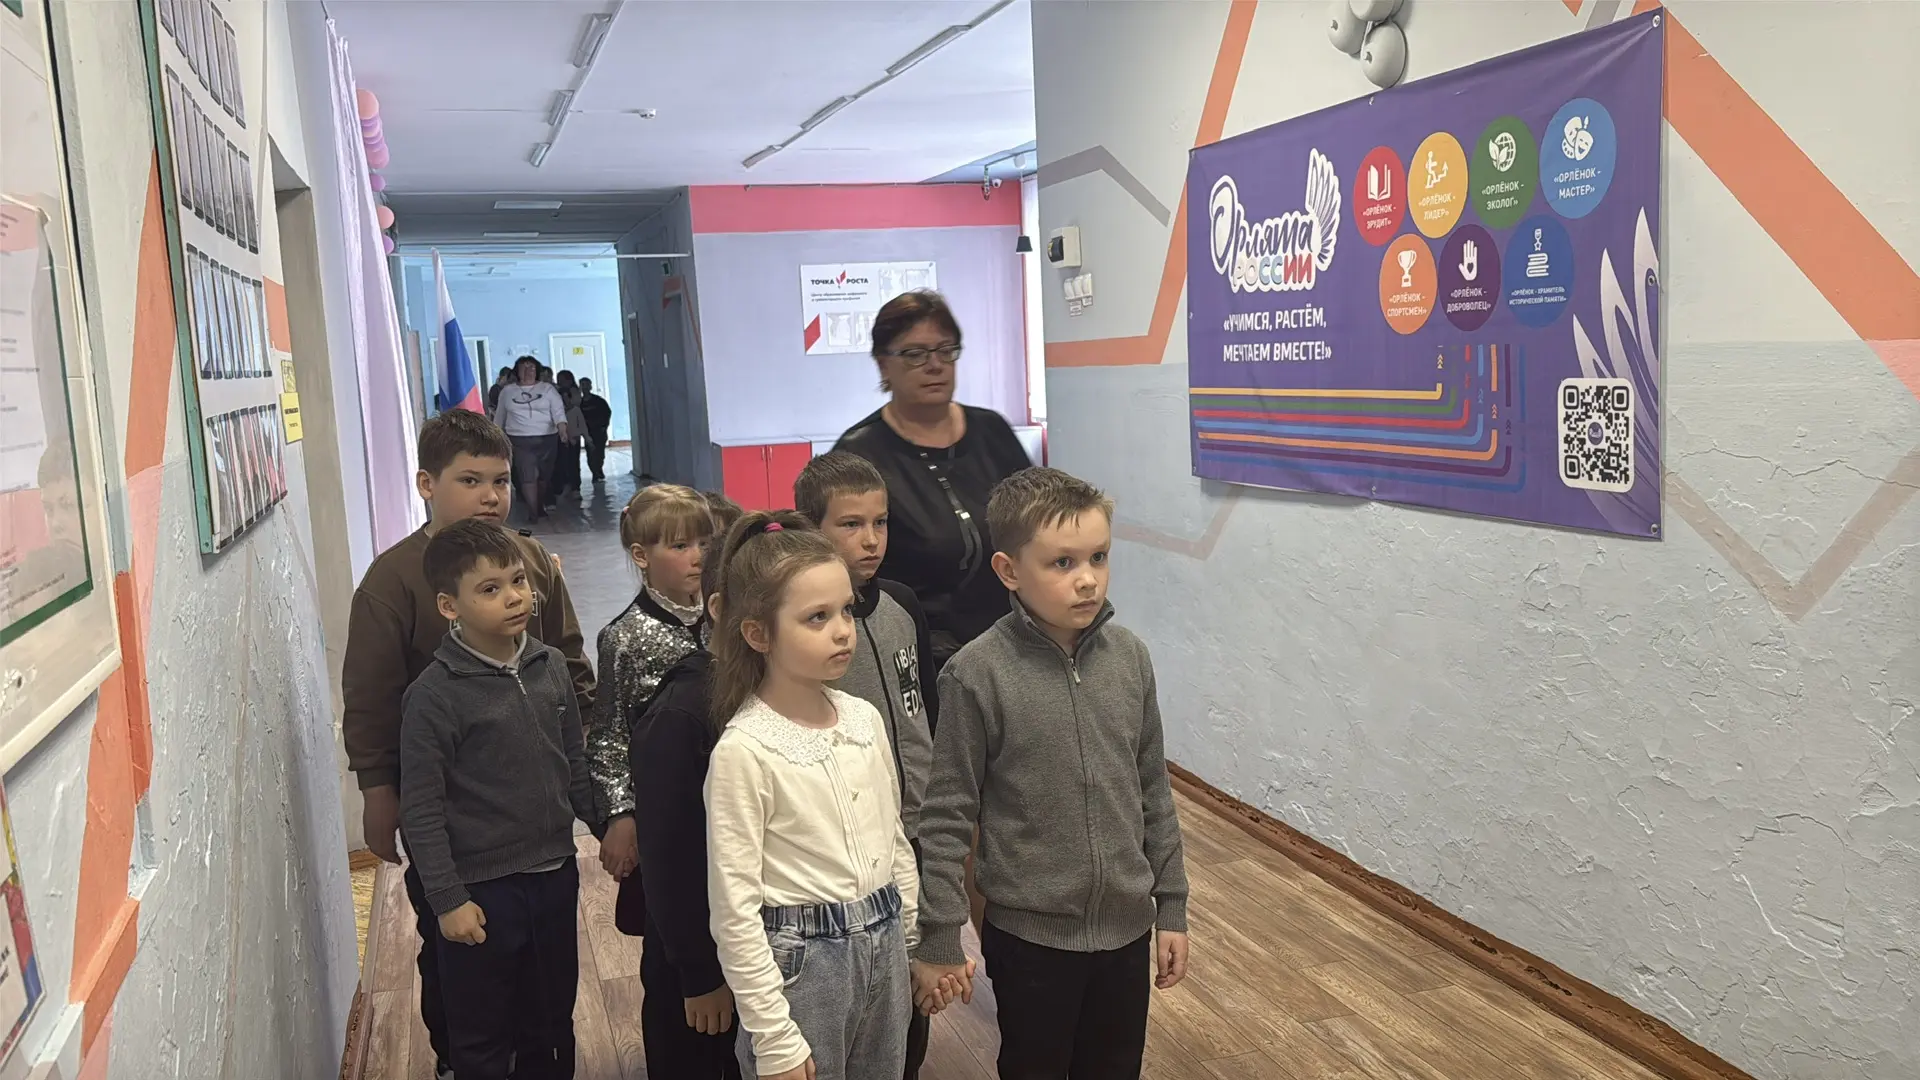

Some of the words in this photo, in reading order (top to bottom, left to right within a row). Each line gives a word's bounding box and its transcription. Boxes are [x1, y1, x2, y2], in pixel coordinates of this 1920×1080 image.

[1553, 167, 1596, 183] «ОРЛЁНОК
[1481, 180, 1520, 195] «ОРЛЁНОК
[1558, 184, 1596, 200] МАСТЕР»
[1486, 196, 1519, 211] ЭКОЛОГ»
[1210, 180, 1315, 278] Орлята
[1232, 252, 1313, 288] РОССИИ
[1389, 291, 1421, 304] «ОРЛЁНОК
[1450, 286, 1483, 298] «ОРЛЁНОК
[1386, 306, 1428, 317] СПОРТСМЕН»
[1446, 301, 1492, 314] ДОБРОВОЛЕЦ»
[1223, 311, 1273, 332] «УЧИМСЯ,
[1275, 302, 1327, 329] РАСТЁМ,
[1223, 343, 1271, 362] МЕЧТАЕМ
[1273, 340, 1332, 361] ВМЕСТЕ!»
